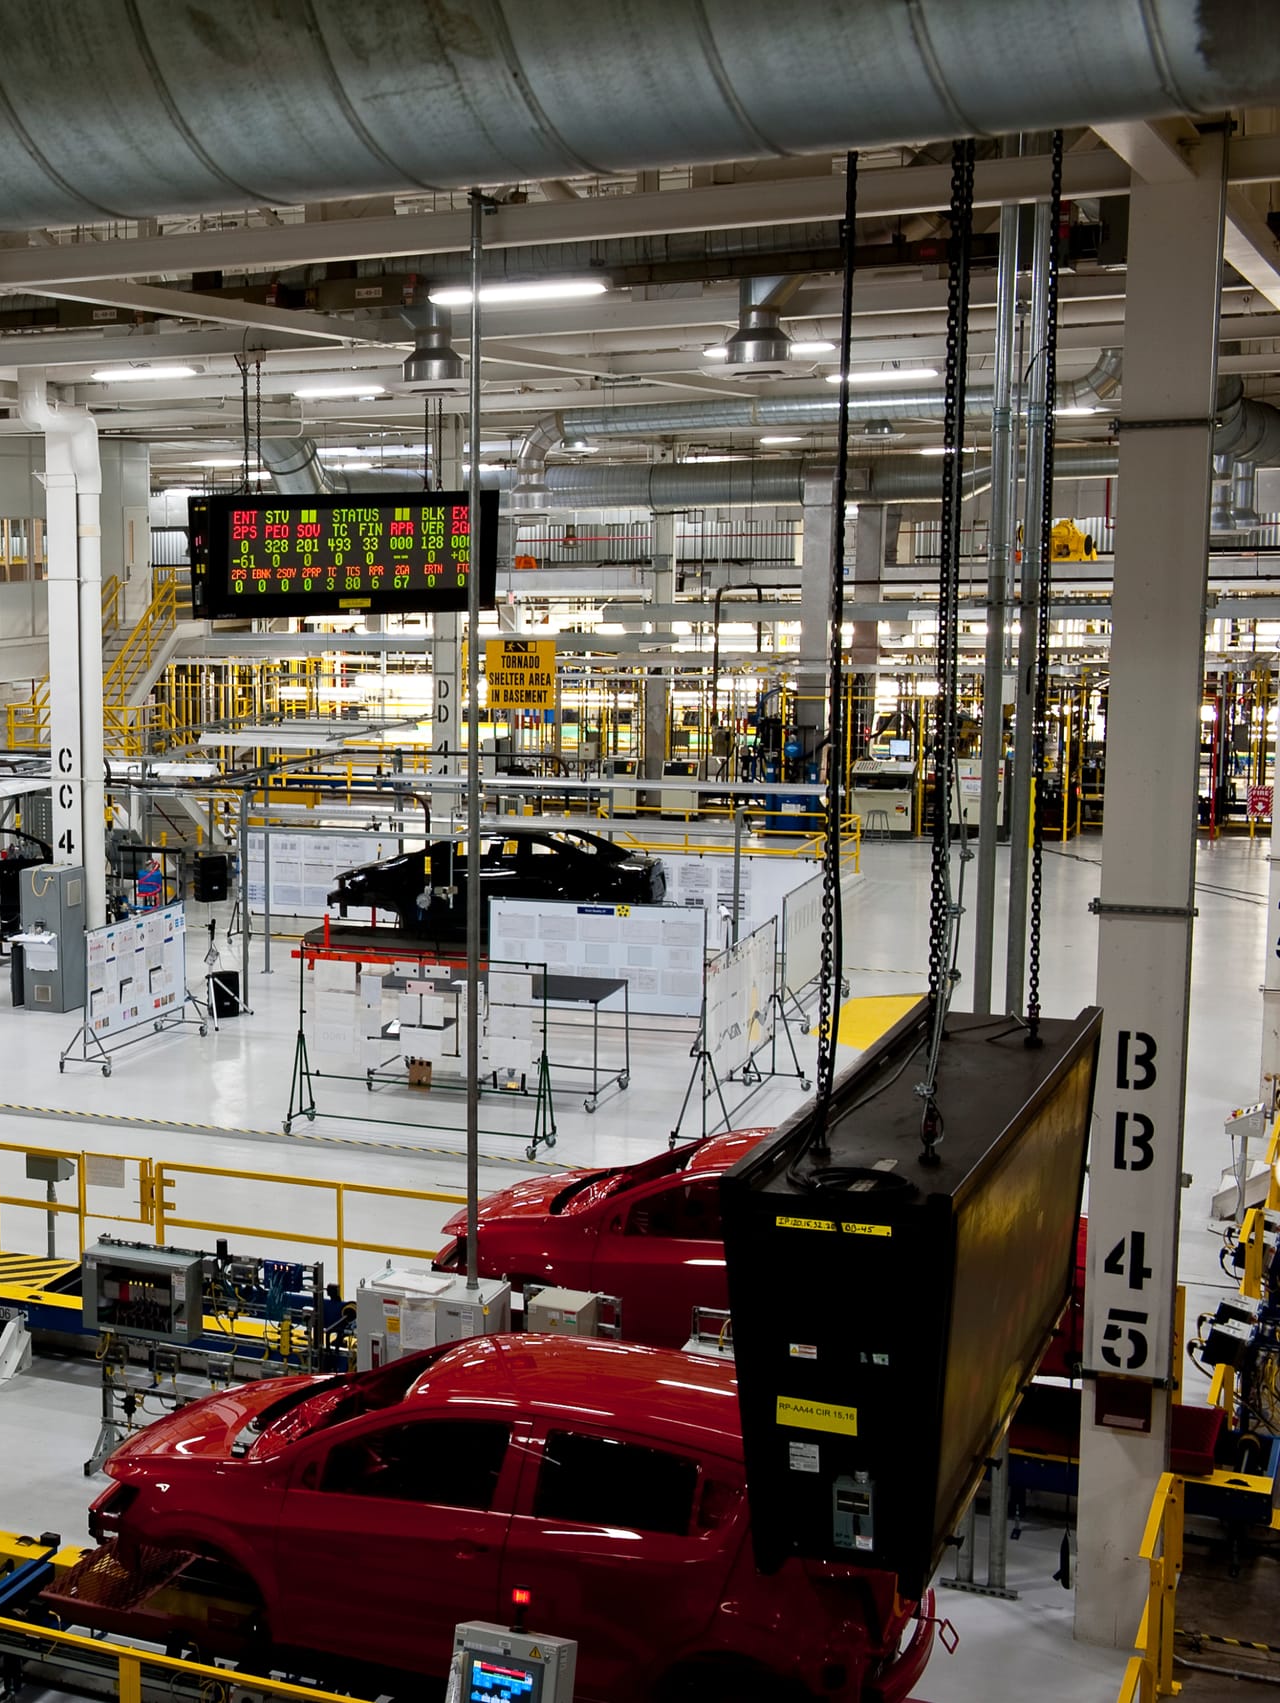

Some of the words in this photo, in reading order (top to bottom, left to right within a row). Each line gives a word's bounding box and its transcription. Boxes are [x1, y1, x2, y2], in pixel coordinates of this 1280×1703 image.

[234, 511, 258, 524] ENT
[266, 510, 289, 523] STV
[332, 508, 379, 522] STATUS
[422, 507, 445, 520] BLK
[452, 506, 469, 520] EX
[233, 526, 257, 539] 2PS
[297, 524, 320, 538] SOV
[332, 524, 348, 536] TC
[360, 522, 382, 536] FIN
[390, 522, 414, 536] RPR
[422, 522, 444, 535] VER
[452, 521, 469, 534] 2G
[241, 540, 248, 554] 0
[265, 540, 288, 553] 328
[296, 539, 319, 552] 201
[328, 538, 352, 552] 493
[362, 538, 378, 550] 33
[390, 536, 413, 550] 000
[422, 536, 444, 549] 128
[232, 555, 256, 568] -61
[272, 554, 280, 567] 0
[304, 553, 311, 566] 0
[335, 552, 342, 566] 0
[366, 552, 374, 565] 0
[428, 550, 435, 563] 0
[231, 569, 247, 580] 2PS
[328, 567, 337, 577] TC
[346, 566, 360, 577] TCS
[368, 565, 384, 576] RPR
[395, 565, 410, 576] 2GA
[424, 564, 443, 574] ERTN
[235, 580, 243, 593] 0
[258, 579, 266, 592] 0
[281, 578, 289, 592] 0
[304, 578, 312, 592] 0
[326, 578, 334, 590] 3
[346, 577, 360, 590] 80
[372, 576, 379, 589] 6
[394, 576, 410, 589] 67
[428, 574, 435, 588] 0
[457, 573, 465, 587] 0
[501, 655, 540, 669] TORNADO
[489, 672, 525, 685] SHELTER
[529, 673, 551, 686] AREA
[492, 689, 500, 702] IN
[504, 690, 548, 703] BASEMENT
[59, 748, 73, 809] CC
[1113, 1030, 1158, 1172] BB
[1101, 1231, 1153, 1369] 45
[779, 1402, 814, 1415] RP-AA44
[816, 1408, 830, 1417] CIR
